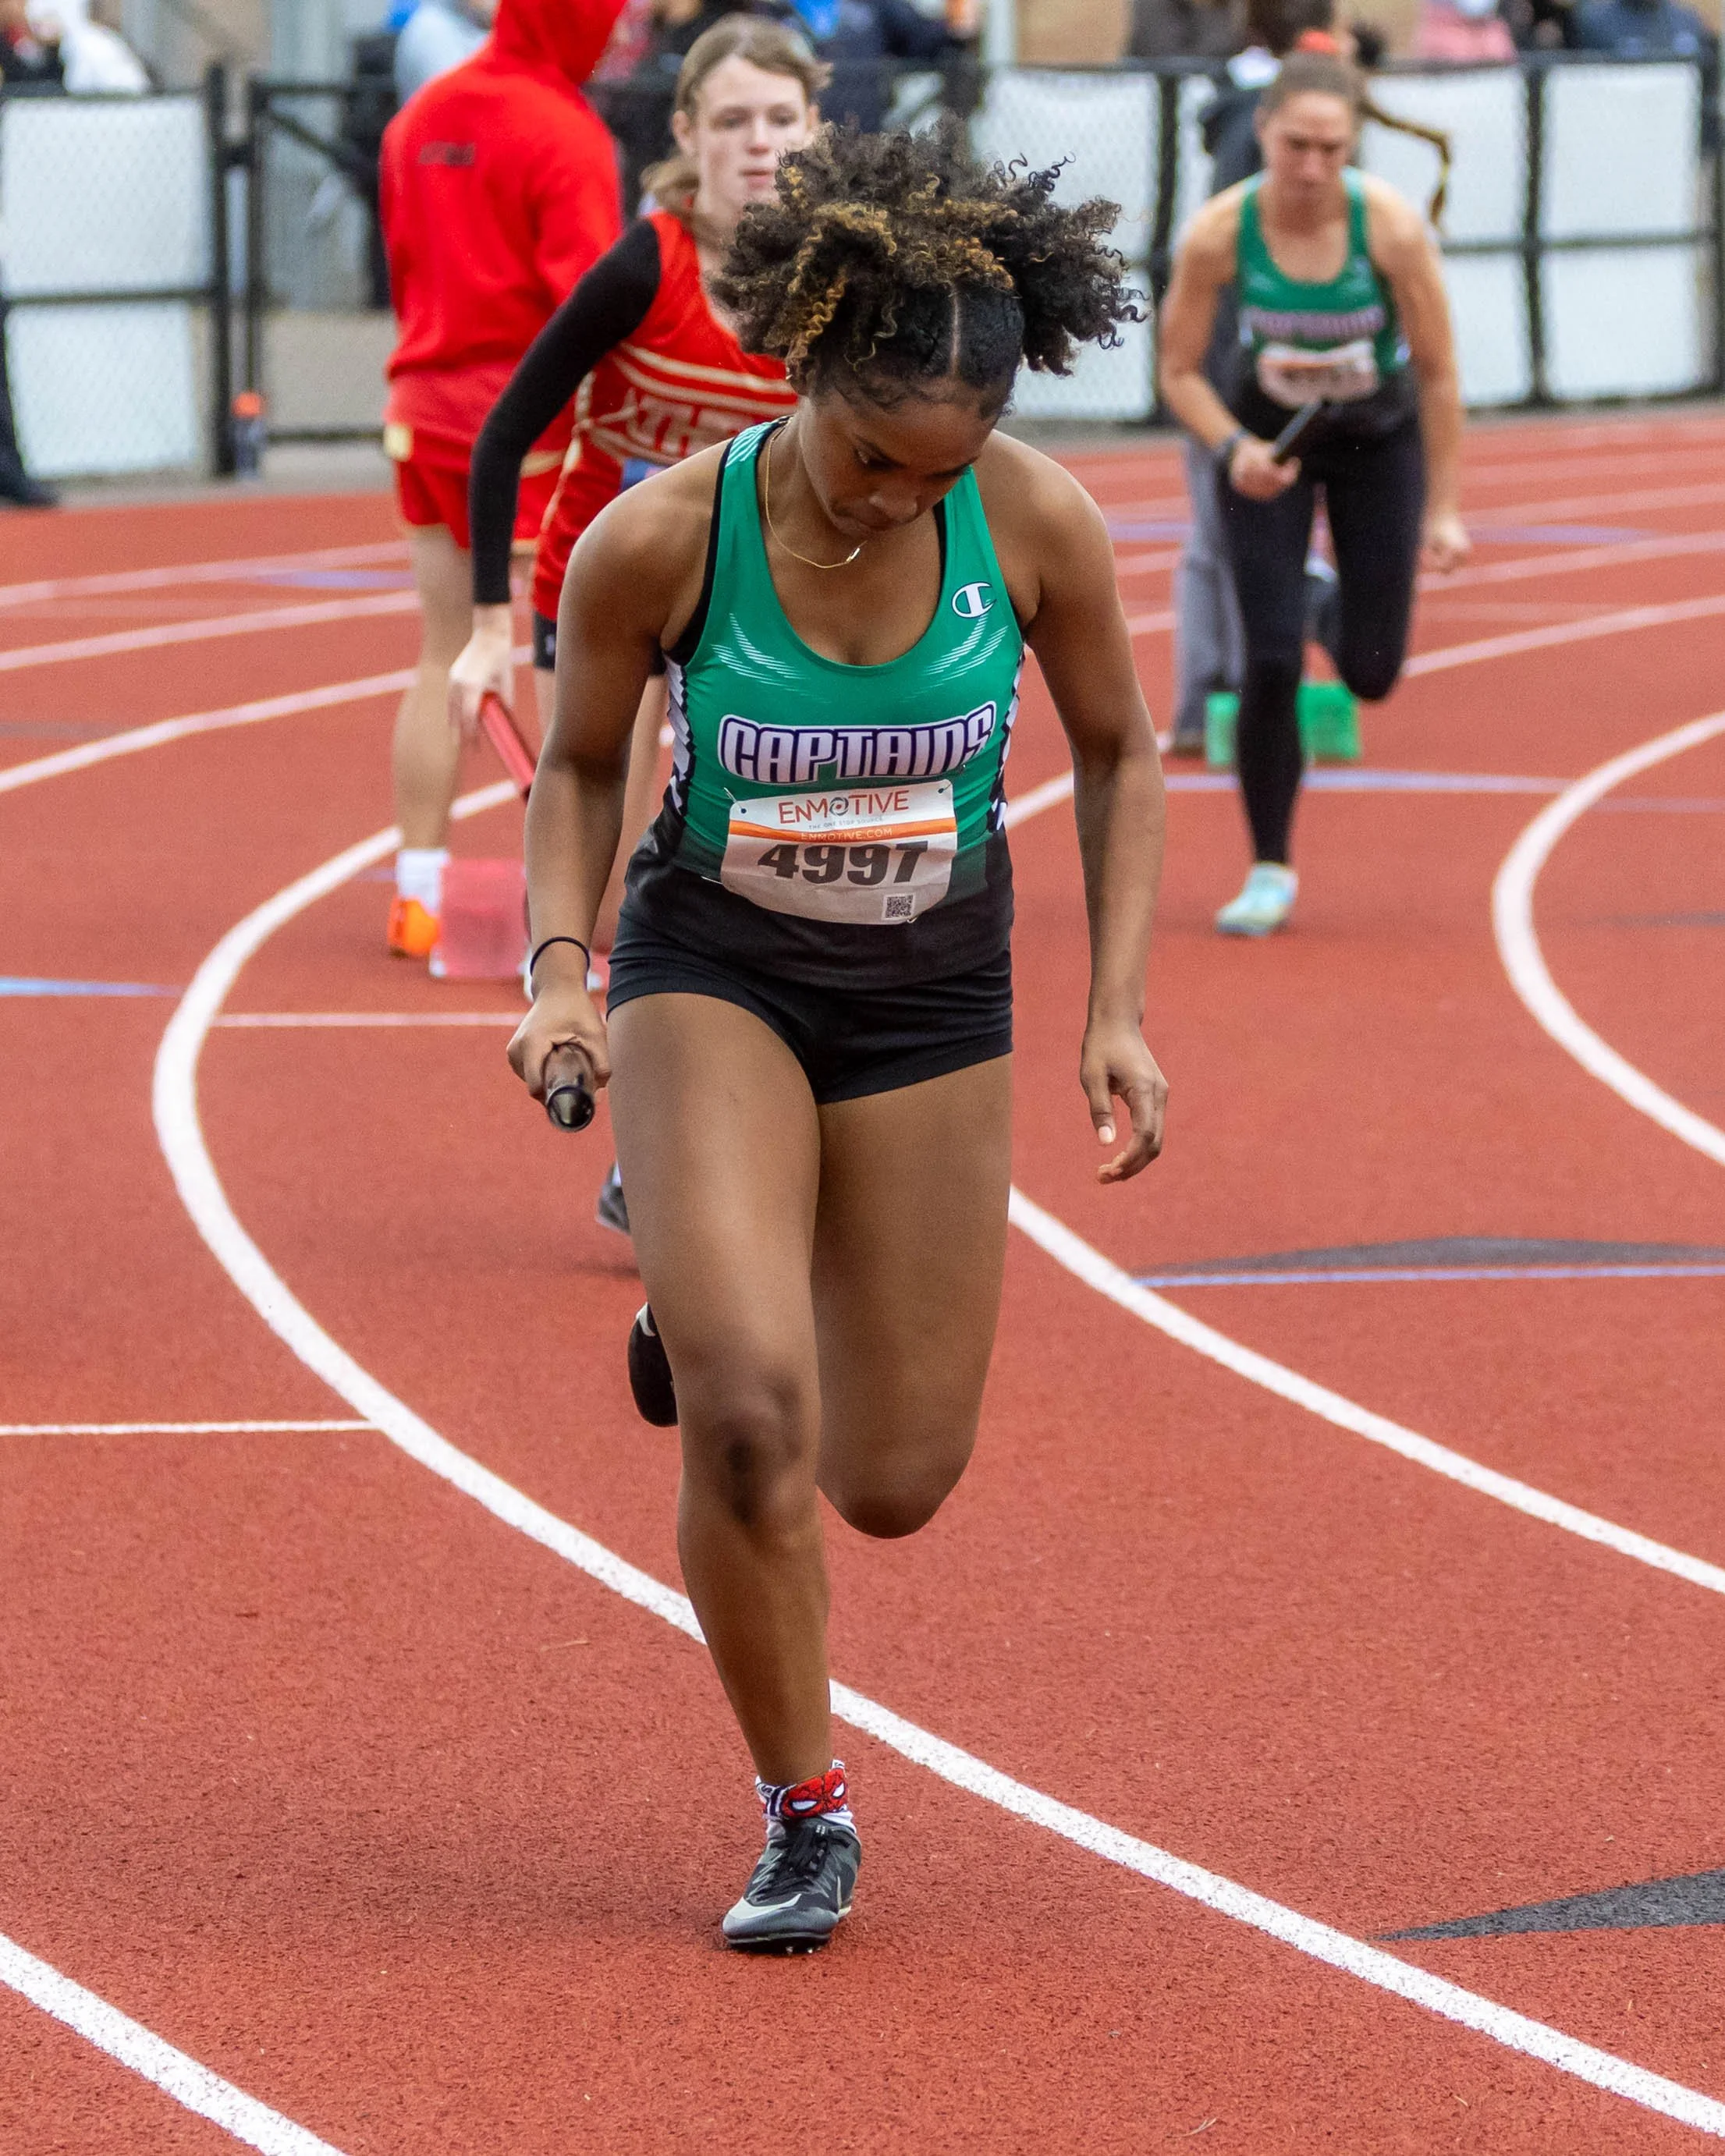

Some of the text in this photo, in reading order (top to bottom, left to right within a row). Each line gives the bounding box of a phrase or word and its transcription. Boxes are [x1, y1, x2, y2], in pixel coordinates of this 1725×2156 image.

[718, 700, 996, 785] CAPTAINS
[800, 828, 893, 841] ENMOTIVE.COM
[757, 839, 928, 886] 4997
